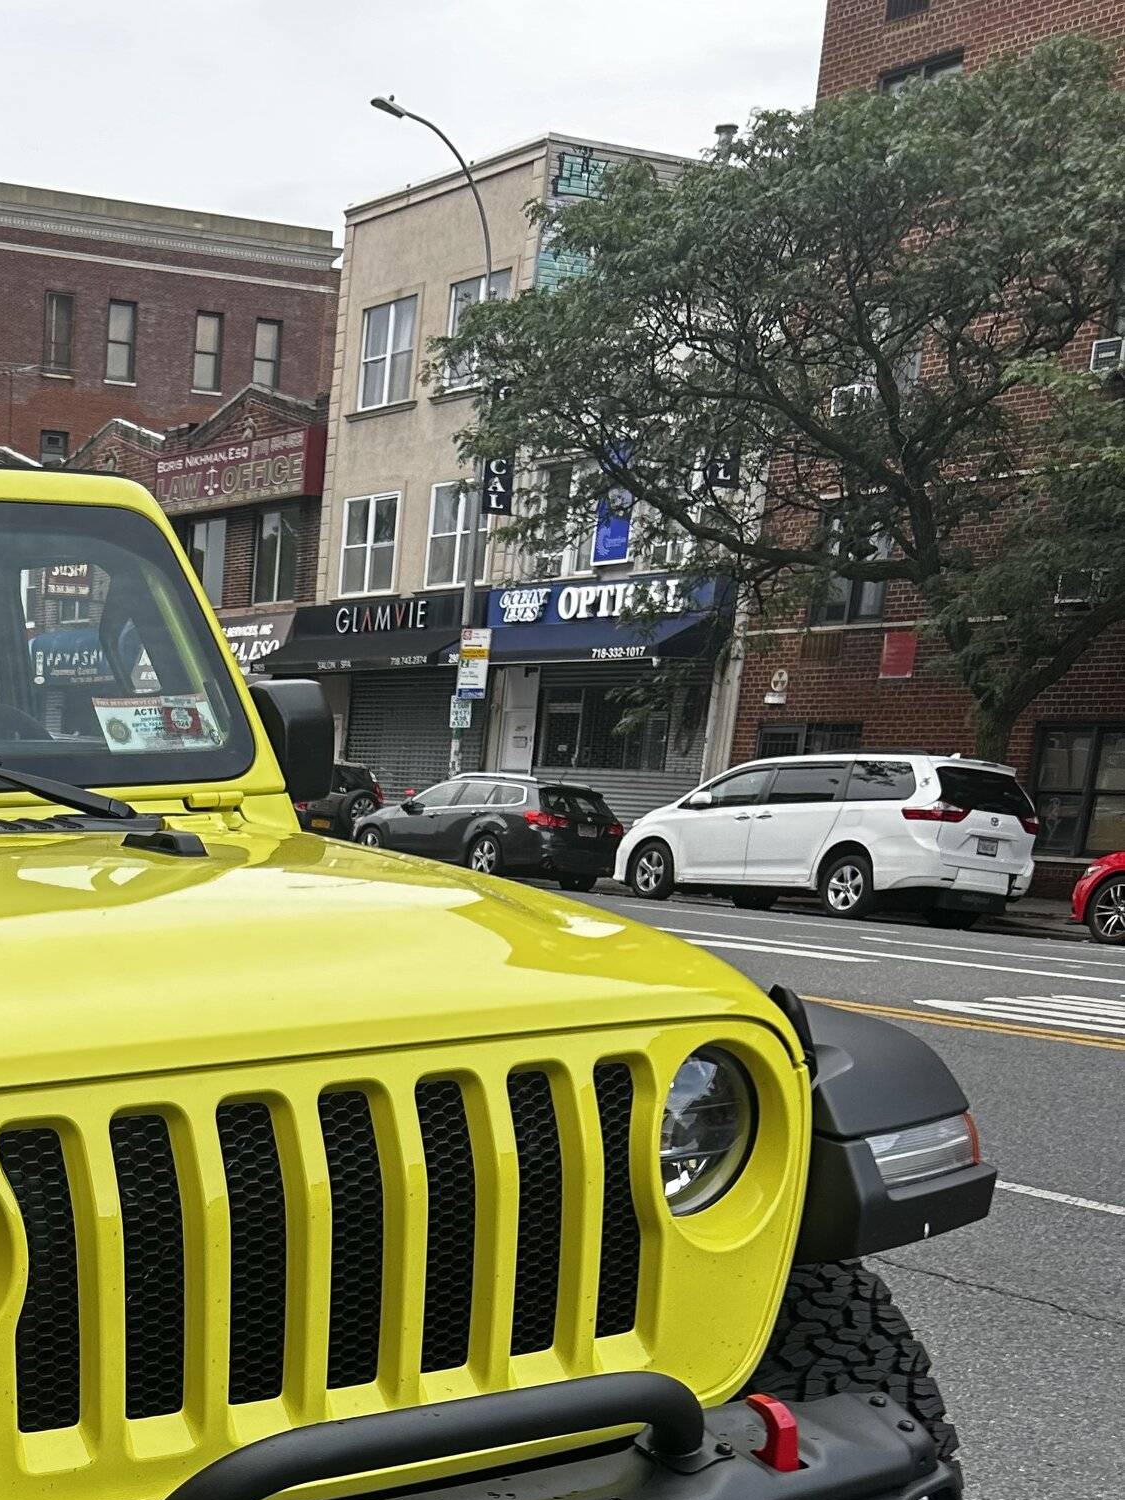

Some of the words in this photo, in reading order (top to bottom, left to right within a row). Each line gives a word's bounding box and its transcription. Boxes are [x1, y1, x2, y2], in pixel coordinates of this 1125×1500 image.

[157, 459, 183, 473] BORIS
[156, 472, 202, 501] LAW
[220, 452, 305, 493] OFFICE
[335, 600, 427, 634] GLAMVIE
[503, 606, 540, 622] EYES
[46, 650, 103, 667] HAYASHI
[591, 646, 645, 659] 718-332-1017
